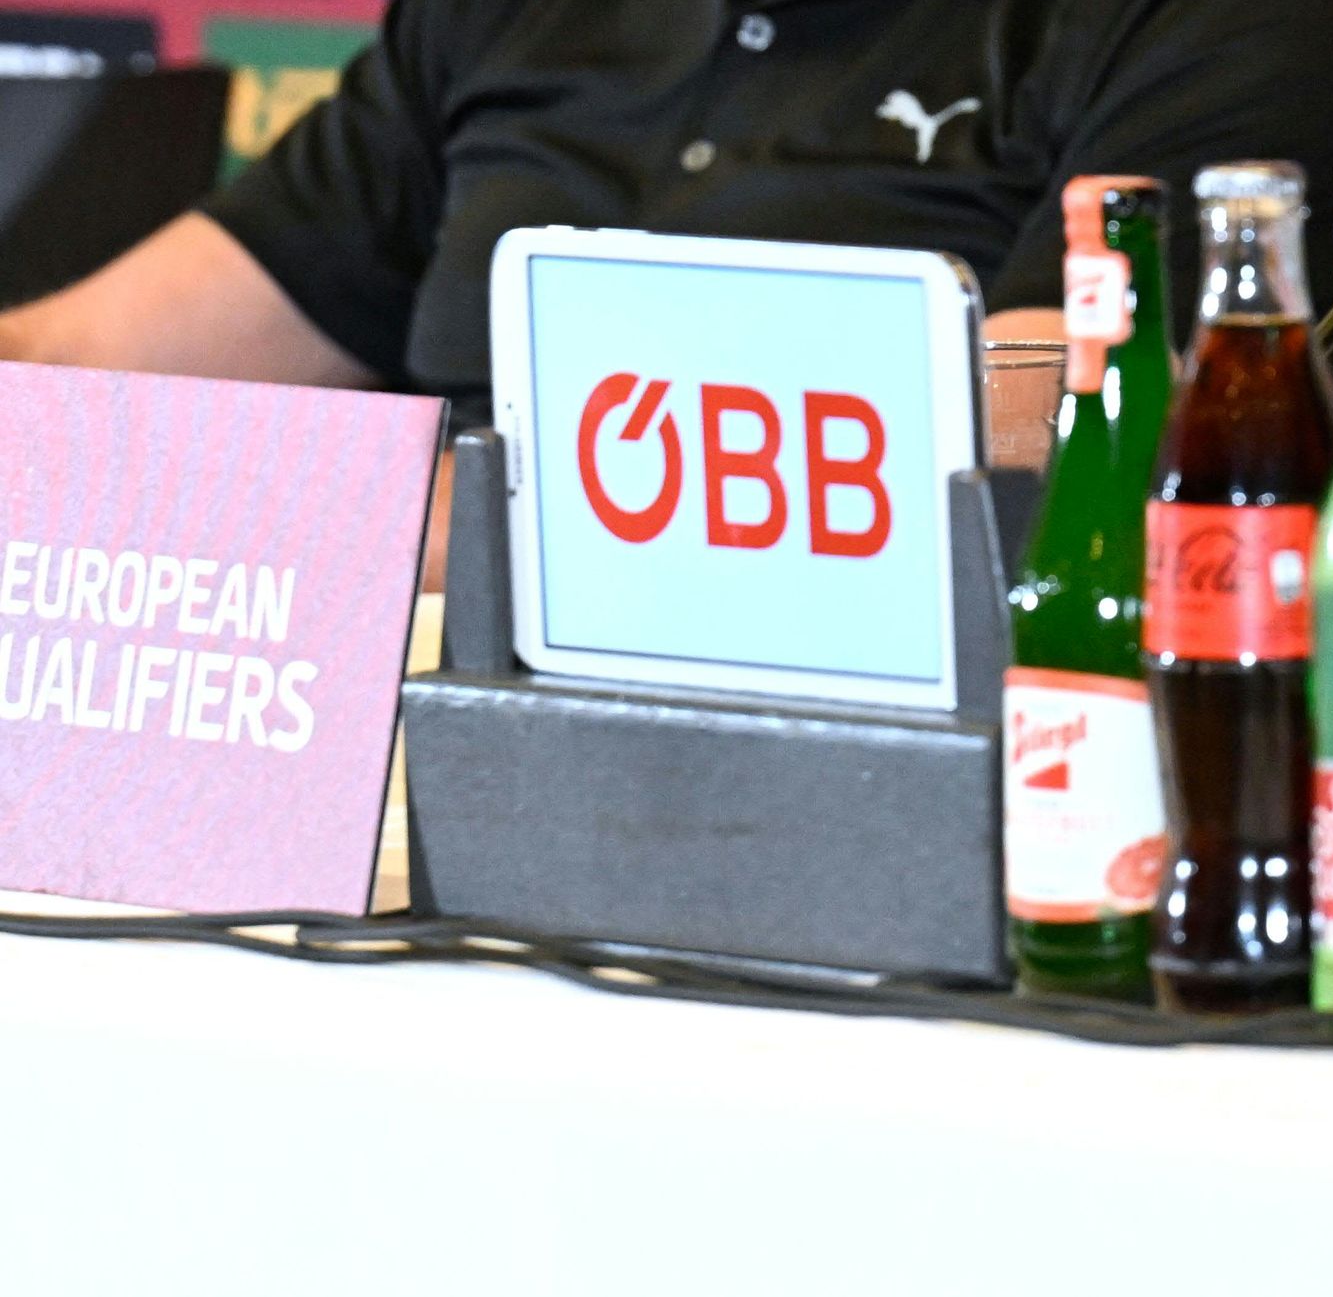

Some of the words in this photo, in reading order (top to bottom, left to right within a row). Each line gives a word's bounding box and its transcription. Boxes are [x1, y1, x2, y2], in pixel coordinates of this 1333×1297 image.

[577, 371, 893, 558] ÖBB
[2, 541, 296, 642] EUROPEAN
[0, 632, 321, 753] UALIFIERS
